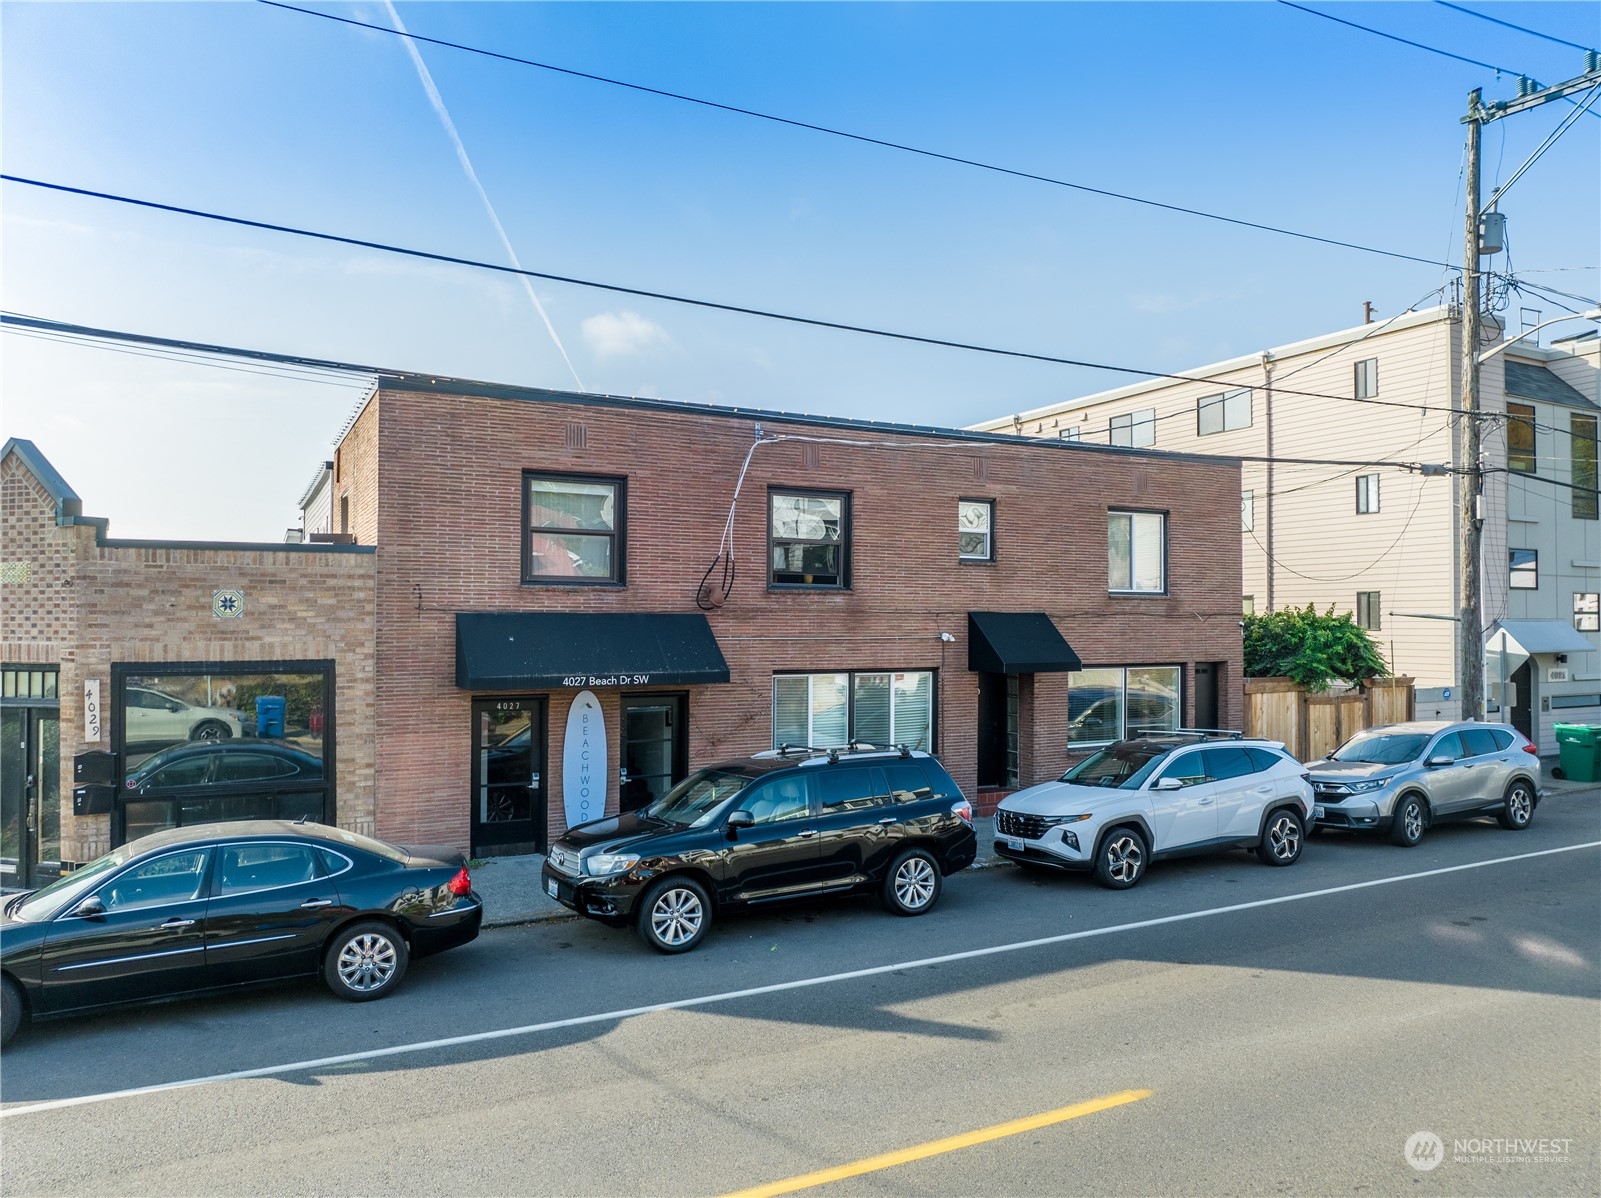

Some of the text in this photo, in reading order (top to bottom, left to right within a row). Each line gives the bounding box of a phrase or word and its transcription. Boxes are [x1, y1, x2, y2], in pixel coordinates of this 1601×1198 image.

[562, 674, 650, 687] 4027 Beach Dr SW
[85, 689, 100, 736] 4029
[496, 702, 520, 710] 4027
[580, 713, 591, 822] BEACHWOOD
